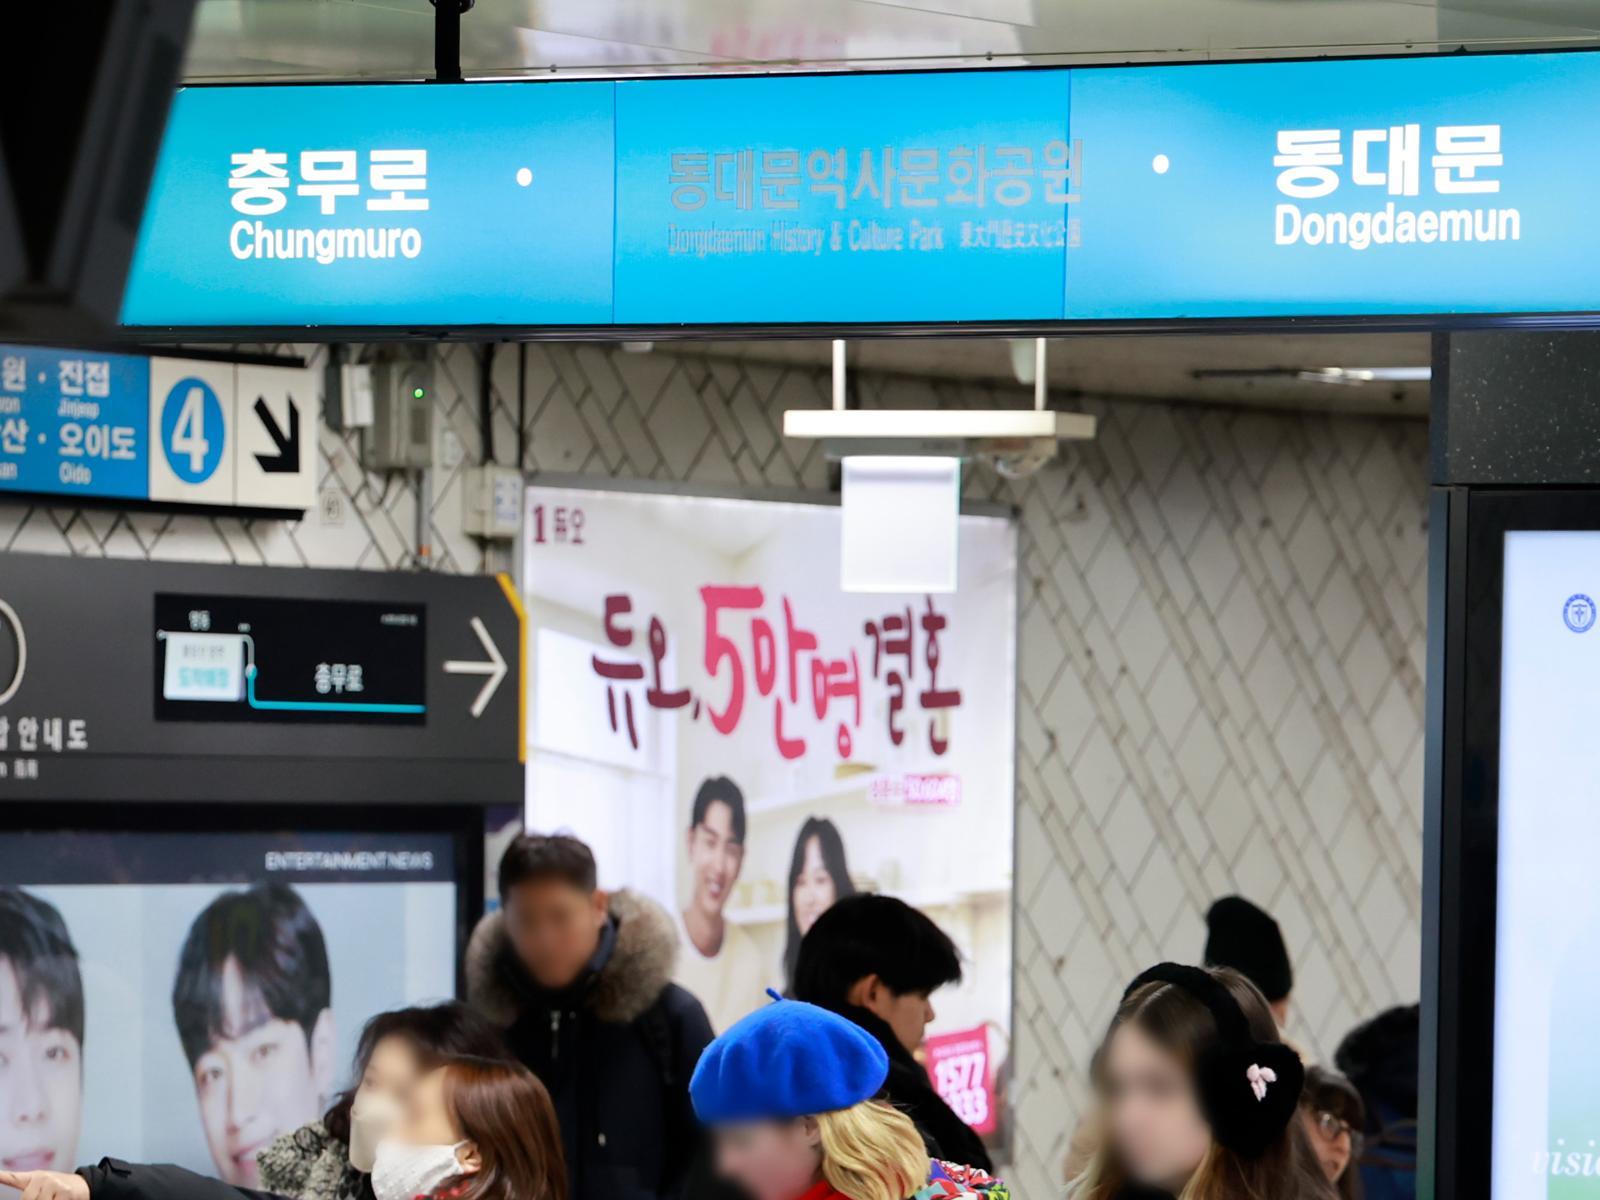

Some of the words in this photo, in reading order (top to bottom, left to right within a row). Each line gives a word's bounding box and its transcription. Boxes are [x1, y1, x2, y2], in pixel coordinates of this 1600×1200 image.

[228, 148, 429, 215] 충무로
[669, 139, 1084, 211] 동대문역사문화공원
[1273, 124, 1503, 198] 동대문
[229, 220, 421, 264] Chungmuro
[668, 222, 764, 258] Dongdaemun
[770, 220, 825, 257] History
[849, 218, 904, 252] Culture
[909, 217, 944, 250] Park
[1274, 202, 1520, 250] Dongdaemun
[58, 360, 110, 398] 진접
[58, 422, 136, 461] 오이도
[171, 386, 209, 473] 4
[59, 461, 92, 485] Oido
[313, 661, 365, 694] 충무로
[700, 584, 863, 760] 5만명
[864, 592, 963, 756] 결혼
[265, 851, 386, 871] ENTERTAINMENT
[388, 851, 434, 870] NEWS
[1531, 1137, 1600, 1178] visi
